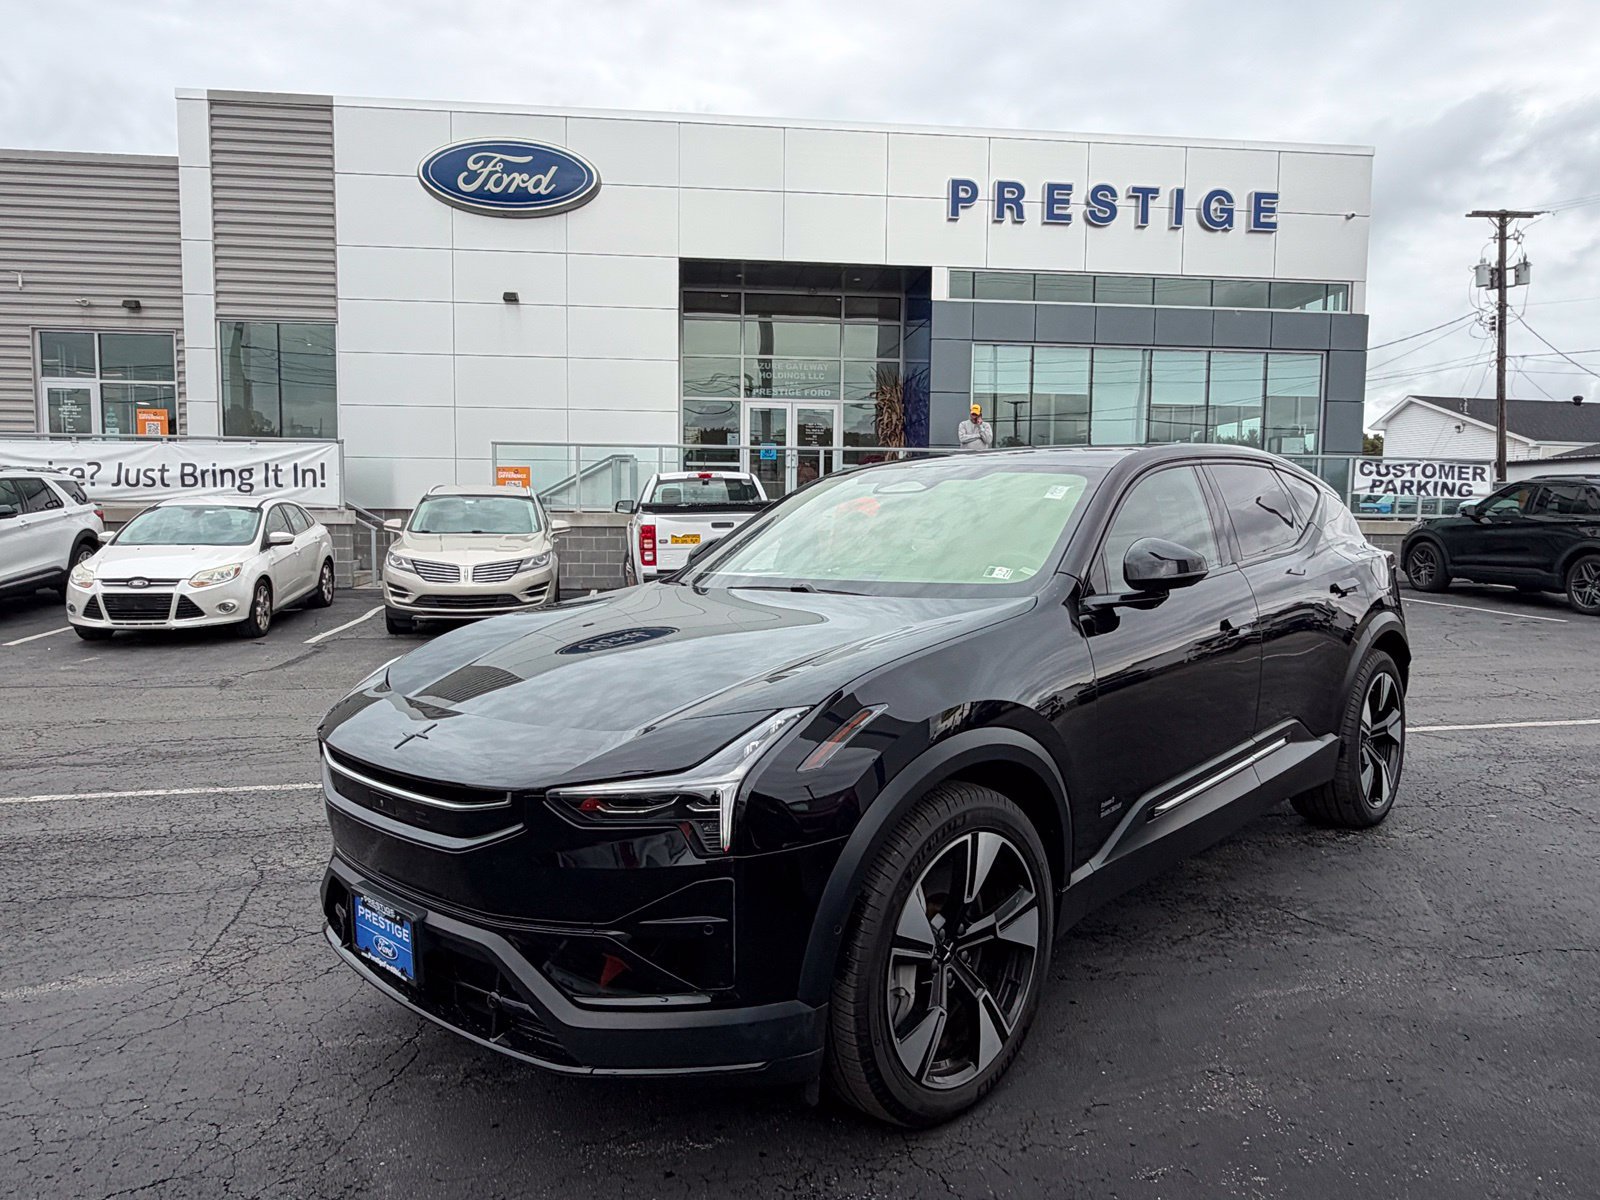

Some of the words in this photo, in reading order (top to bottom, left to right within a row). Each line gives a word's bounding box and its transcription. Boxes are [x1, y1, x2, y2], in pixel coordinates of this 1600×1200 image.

[457, 152, 558, 195] Ford
[947, 178, 1280, 233] PRESTIGE
[759, 372, 806, 380] HOLDINGS
[808, 372, 825, 380] LLC
[786, 363, 829, 371] GATEWAY
[752, 388, 801, 396] PRESTIGE
[804, 389, 831, 397] FORD
[111, 461, 171, 489] Just
[180, 462, 255, 494] Bring
[263, 462, 284, 489] It
[293, 462, 327, 489] In!
[1359, 460, 1487, 483] CUSTOMER
[1369, 479, 1474, 498] PARKING
[358, 904, 410, 942] PRESTIGE
[377, 936, 394, 957] Ford
